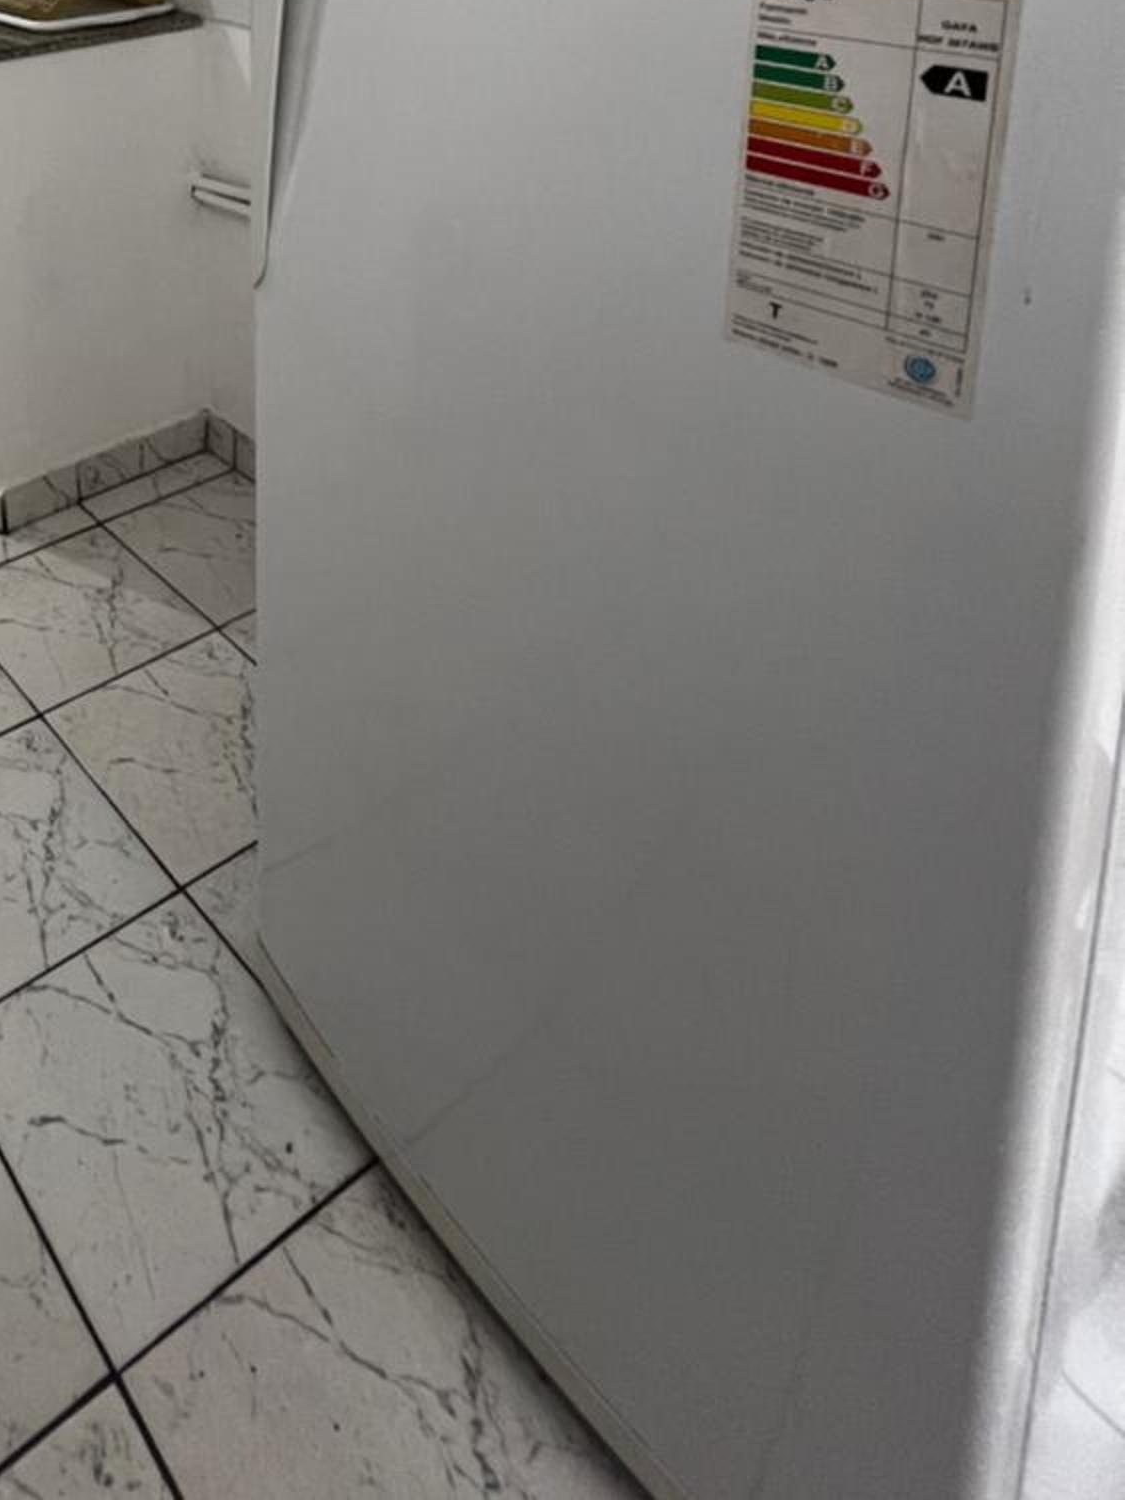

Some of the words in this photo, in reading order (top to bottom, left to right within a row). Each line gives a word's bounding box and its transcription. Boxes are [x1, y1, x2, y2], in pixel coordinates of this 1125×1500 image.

[815, 54, 832, 71] A
[824, 74, 838, 91] B
[943, 71, 972, 98] A
[860, 160, 873, 178] F
[868, 182, 885, 199] G
[768, 301, 784, 320] T
